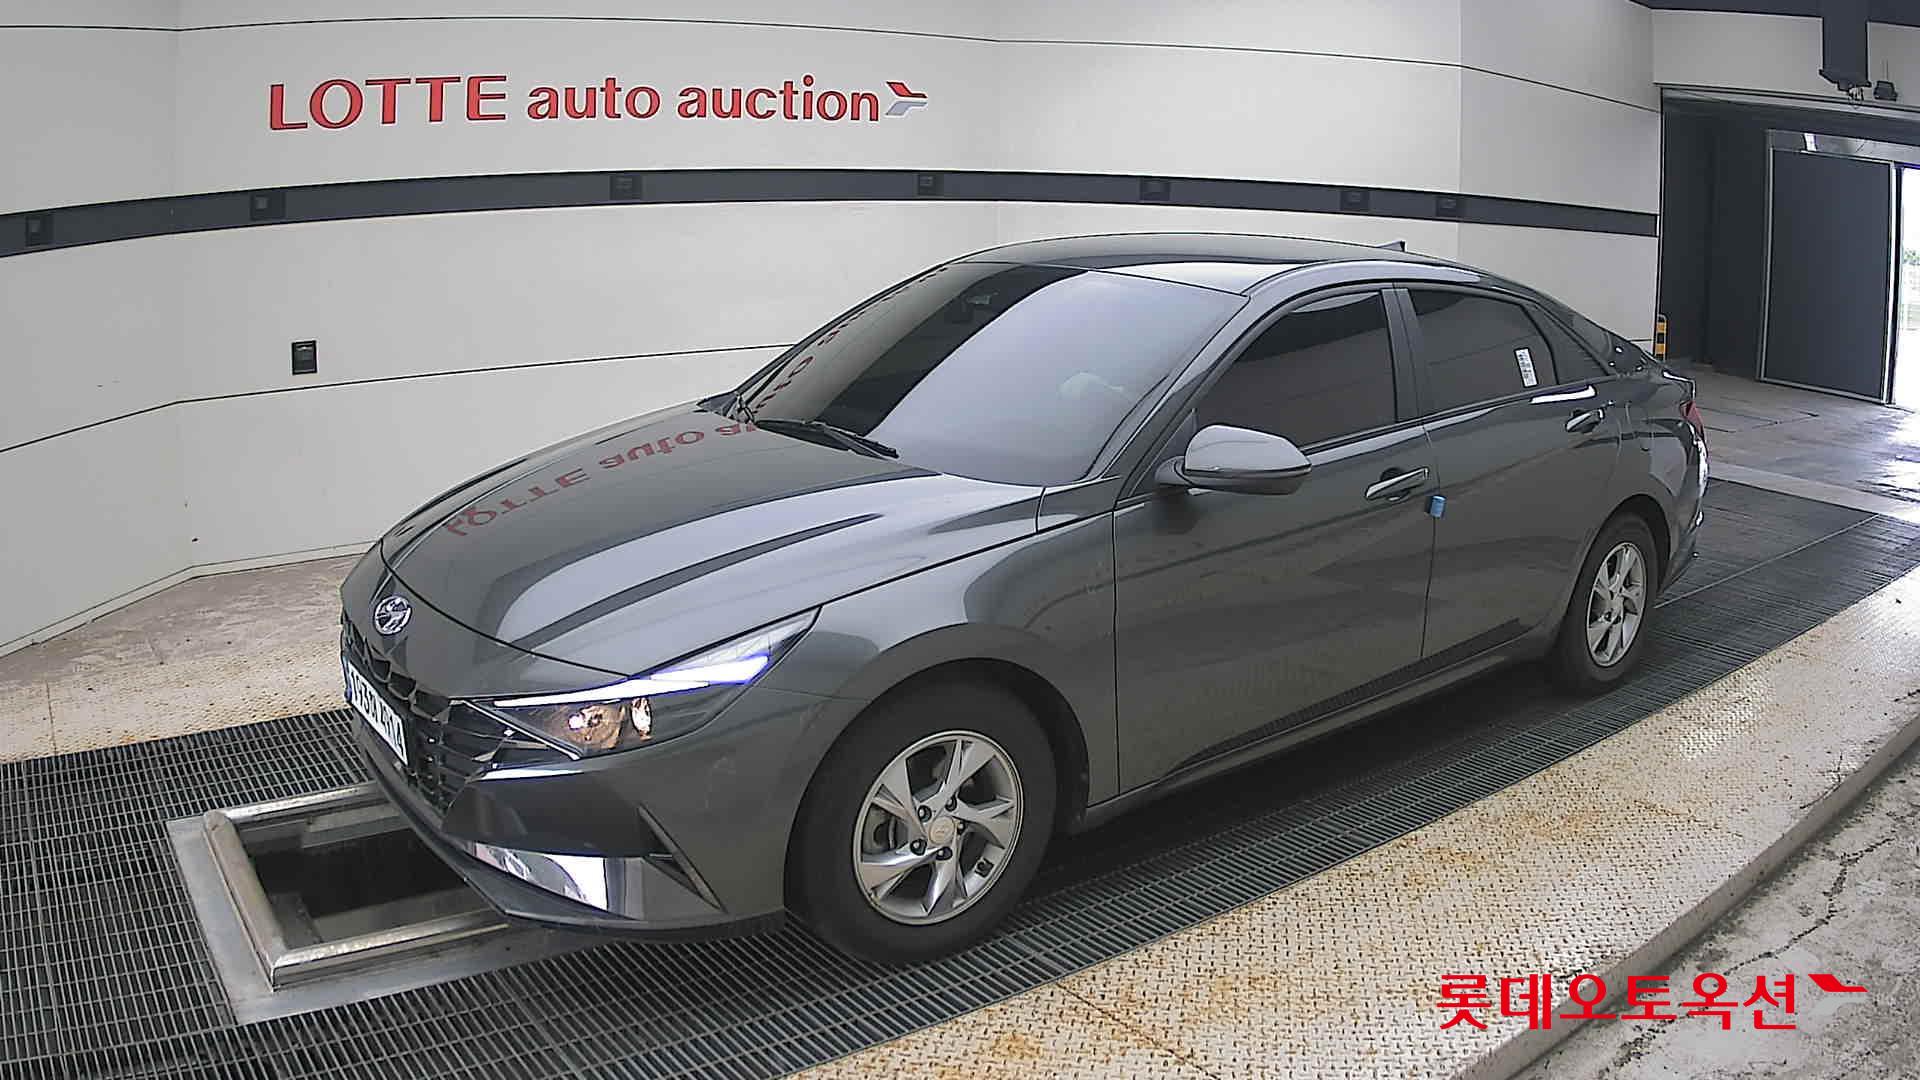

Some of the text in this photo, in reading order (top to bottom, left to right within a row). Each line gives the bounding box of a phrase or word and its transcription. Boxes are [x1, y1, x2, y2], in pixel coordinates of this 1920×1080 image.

[269, 74, 880, 131] LOTTE auto auction
